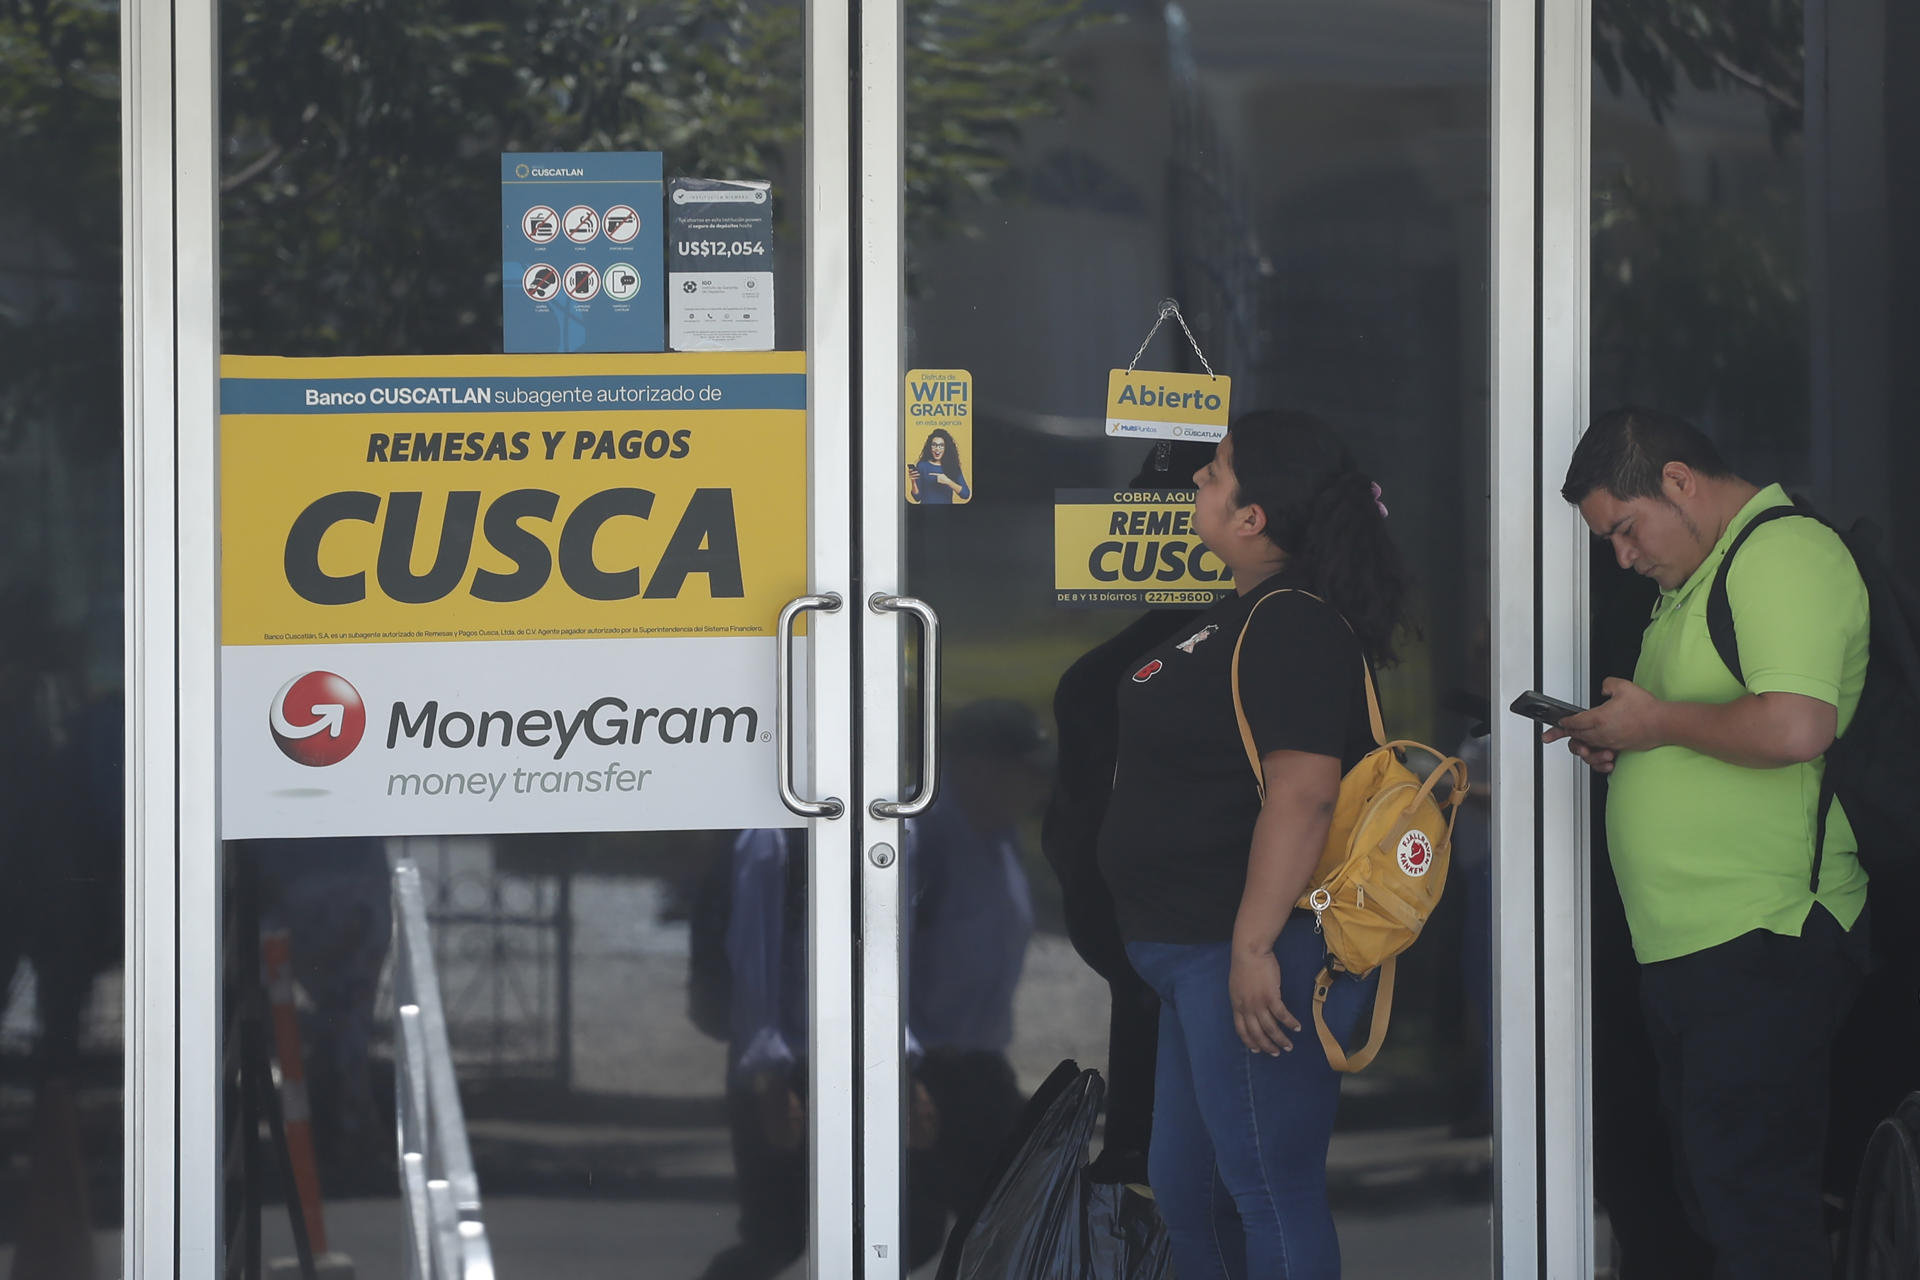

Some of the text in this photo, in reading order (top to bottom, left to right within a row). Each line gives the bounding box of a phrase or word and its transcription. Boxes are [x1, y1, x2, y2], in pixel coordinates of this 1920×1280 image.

[531, 168, 584, 177] CUSCATLAN
[678, 240, 765, 258] US$12,054
[305, 385, 722, 407] Banco CUSCATLAN subagente autorizado de
[910, 382, 968, 402] WIFI
[1117, 384, 1221, 411] Abierto
[910, 403, 968, 416] GRATIS
[1184, 430, 1222, 438] CUSCATLAN
[366, 429, 692, 463] REMESAS Y PAGOS
[1113, 492, 1198, 503] COBRA AQU
[283, 487, 745, 606] CUSCA
[1100, 591, 1137, 601] DÍGITOS
[1149, 593, 1212, 602] 2271-9600
[348, 631, 381, 640] subagente
[382, 630, 415, 638] autorizado
[458, 629, 478, 638] Pagos
[516, 628, 524, 636] de
[537, 628, 560, 636] Agente
[561, 628, 586, 636] pagador
[587, 626, 620, 634] autorizado
[621, 627, 631, 635] por
[639, 626, 693, 634] Superintendencia
[386, 762, 653, 802] money transfer
